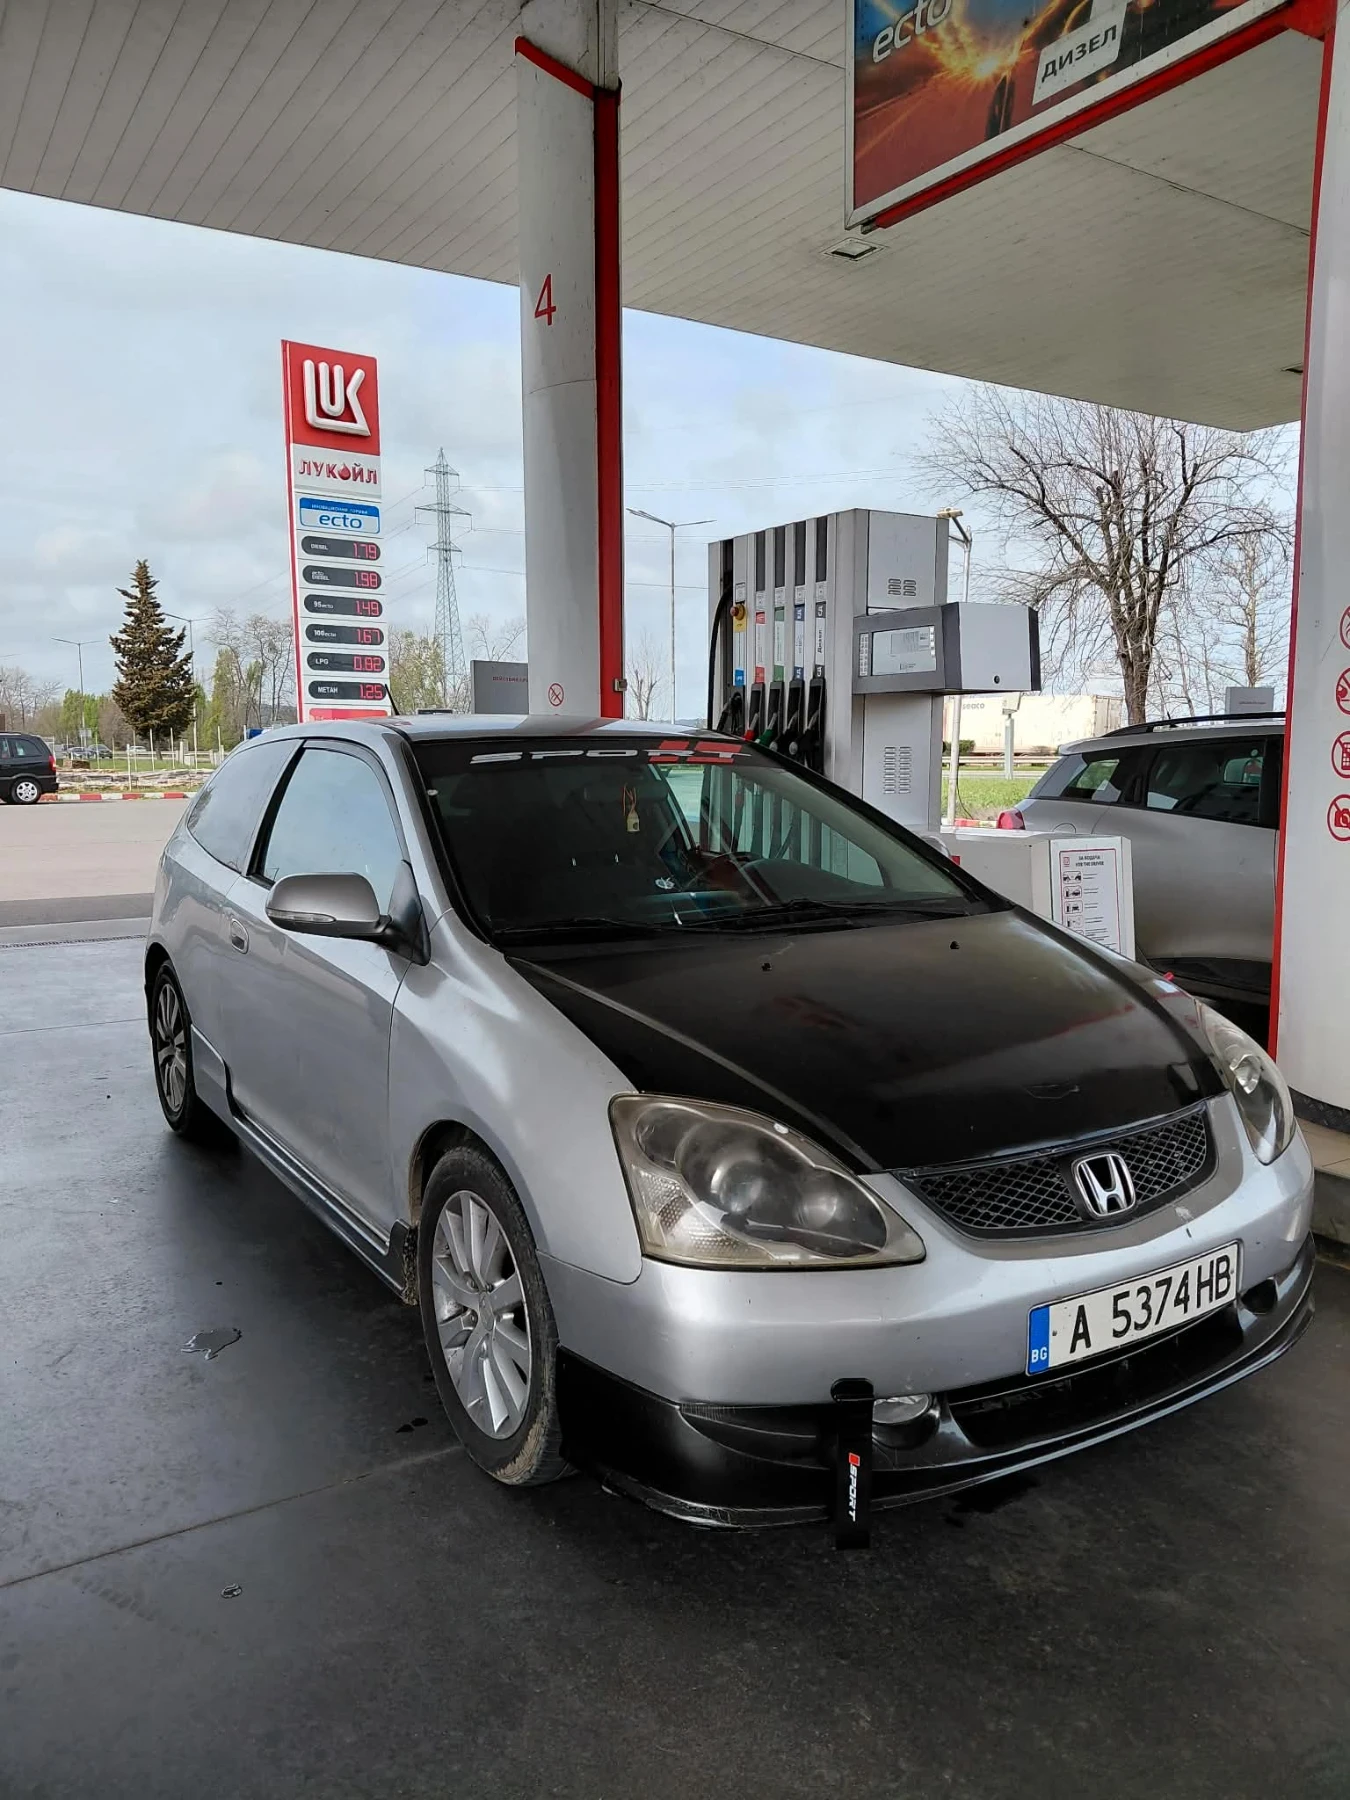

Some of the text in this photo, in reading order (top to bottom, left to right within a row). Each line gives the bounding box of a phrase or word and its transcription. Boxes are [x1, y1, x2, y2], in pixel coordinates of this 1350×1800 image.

[873, 0, 950, 63] ecto
[1041, 24, 1117, 83] ДИЗЕЛ
[534, 273, 557, 326] 4
[319, 514, 362, 529] ecto
[470, 749, 752, 765] SPORT
[1070, 1304, 1091, 1354] A
[1112, 1270, 1190, 1338] 5374
[1030, 1346, 1048, 1364] BG
[849, 1463, 858, 1522] SPORT
